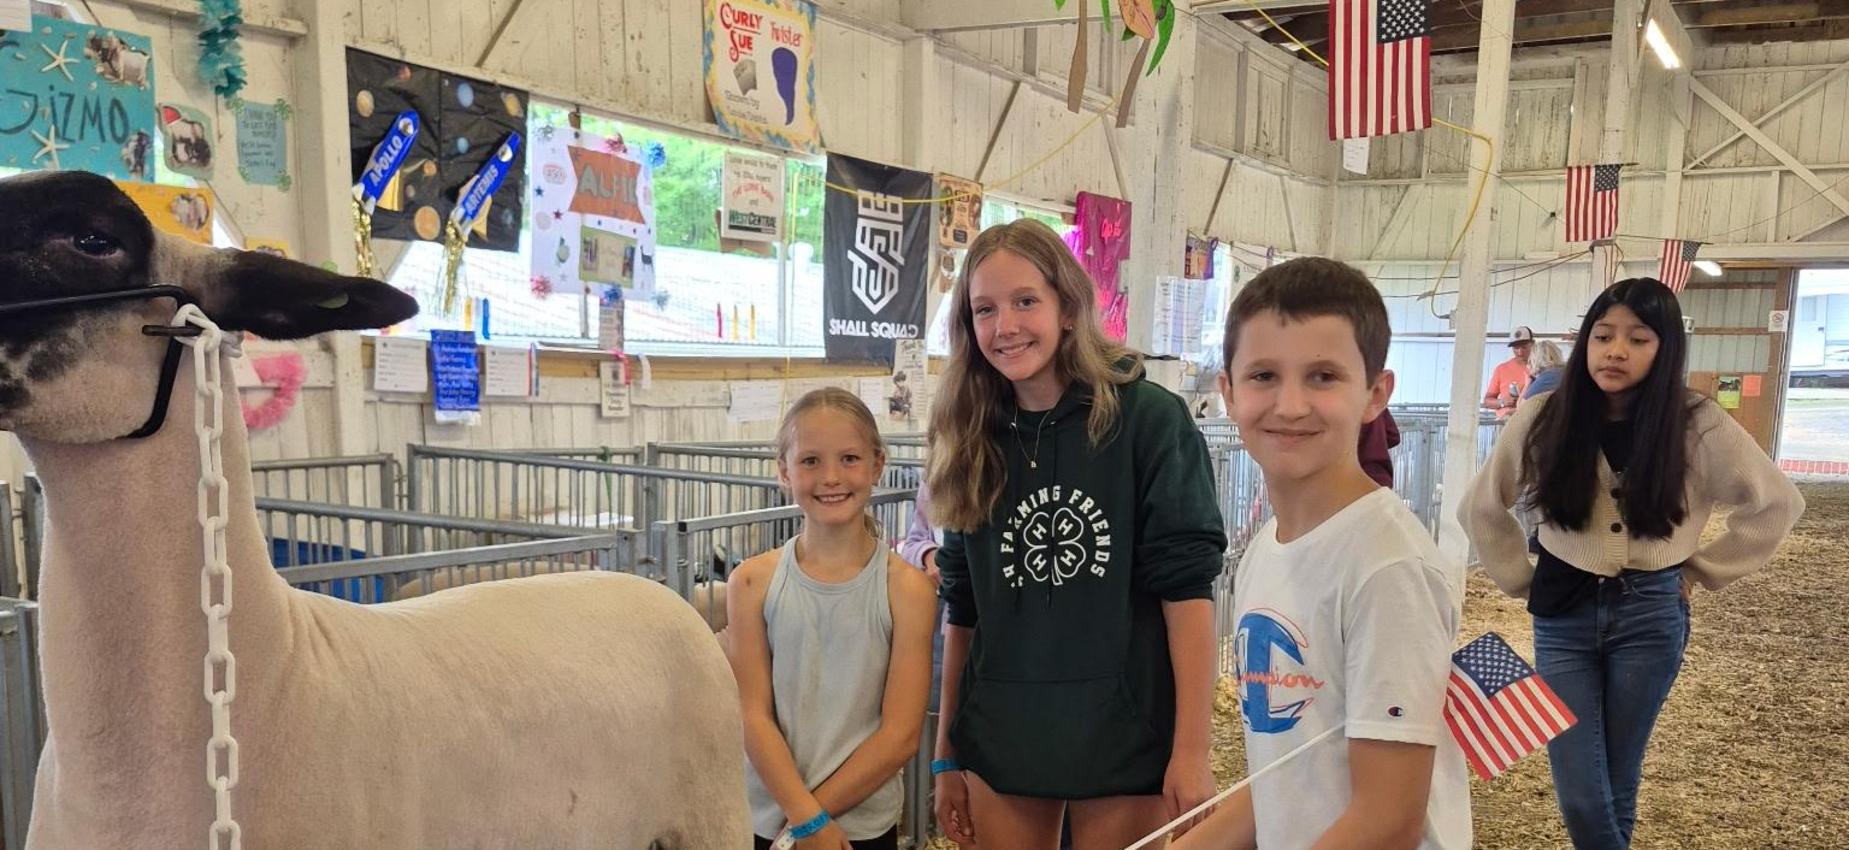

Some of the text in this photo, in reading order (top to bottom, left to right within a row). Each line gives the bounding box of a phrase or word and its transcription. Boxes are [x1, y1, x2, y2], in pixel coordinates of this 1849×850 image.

[720, 2, 763, 30] CURLY
[729, 30, 753, 63] SUE
[369, 135, 403, 187] APOLLO
[465, 164, 499, 214] ARTEMIS
[829, 318, 919, 339] SHALL SQUAD
[1068, 489, 1111, 577] FRIENDS
